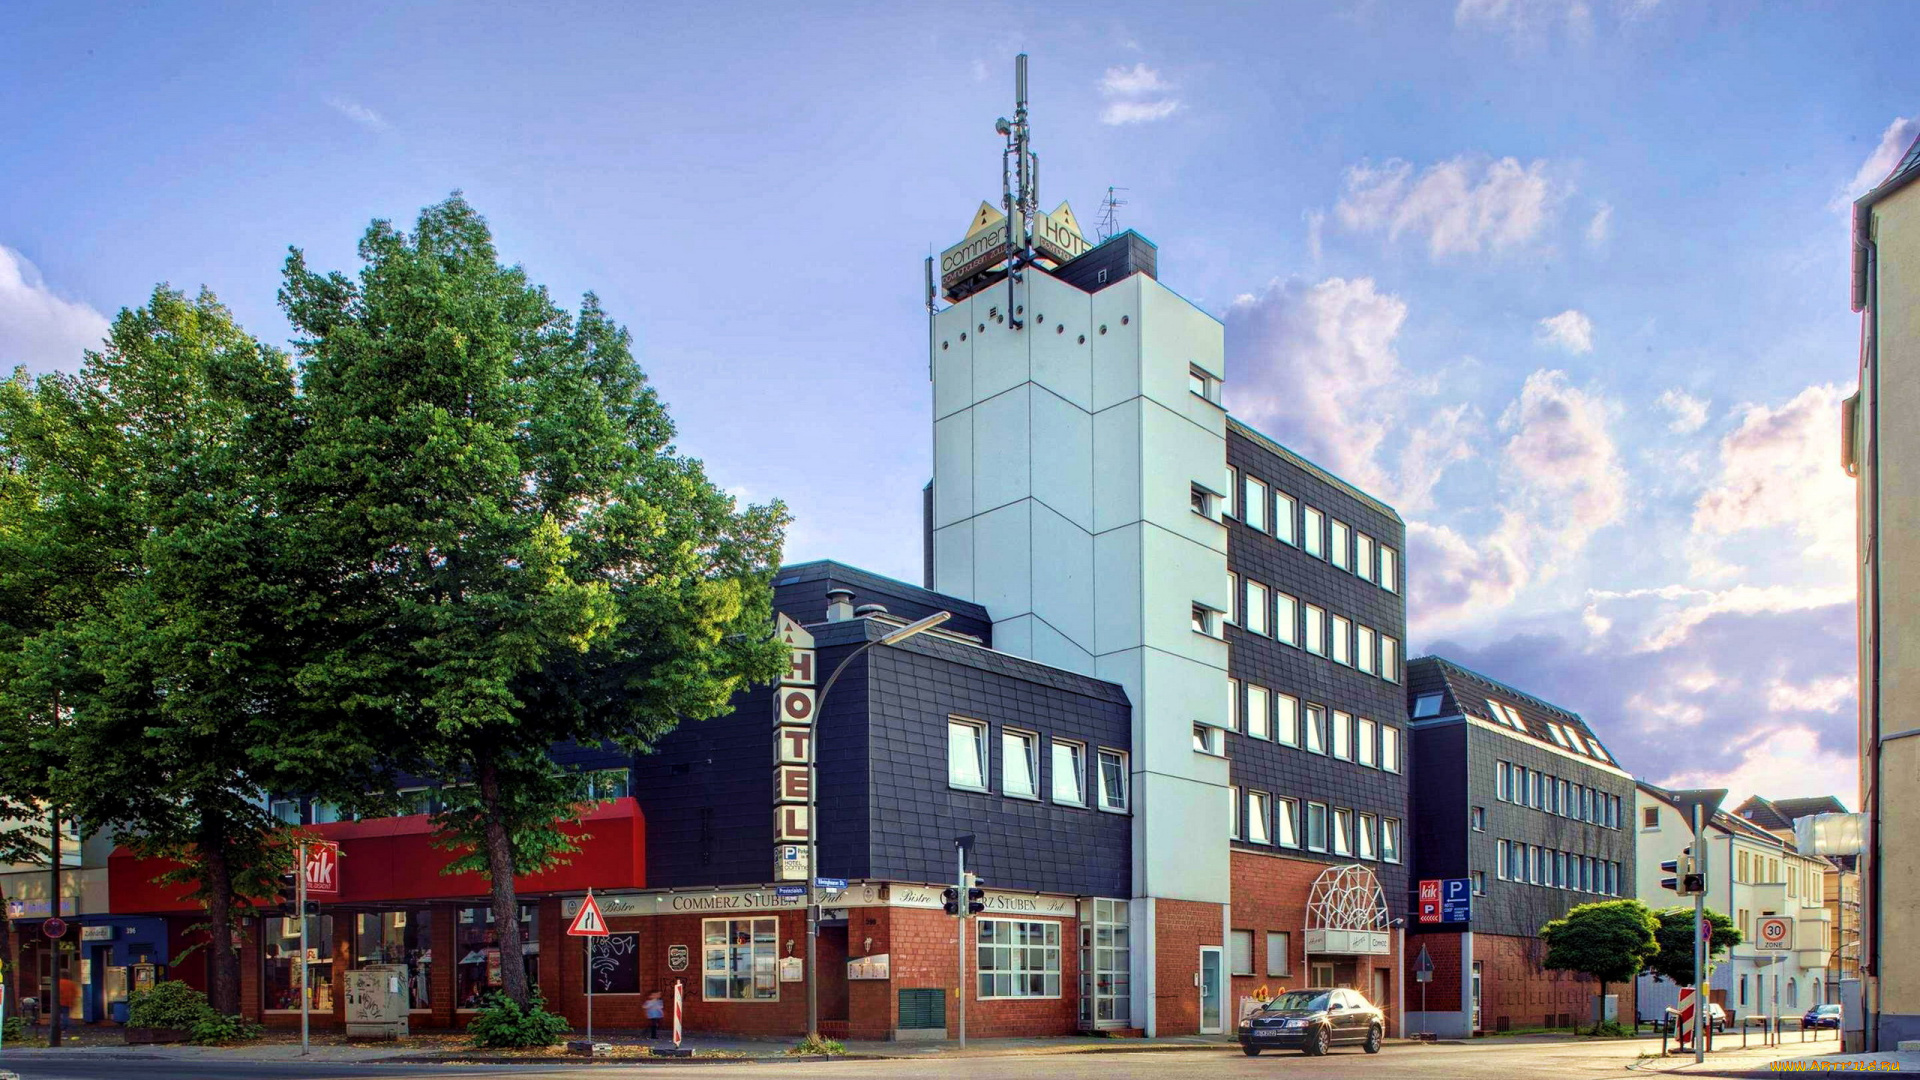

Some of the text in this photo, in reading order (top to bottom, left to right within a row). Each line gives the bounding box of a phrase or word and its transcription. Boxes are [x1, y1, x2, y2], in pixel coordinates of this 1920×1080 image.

[1046, 216, 1093, 255] HOTE
[943, 226, 1008, 272] commer
[785, 654, 812, 837] HOTEL
[816, 891, 845, 903] Pub
[900, 889, 931, 904] Bistro
[1422, 882, 1437, 898] kik
[1450, 881, 1463, 898] P
[601, 901, 635, 912] Bistro
[1047, 900, 1065, 911] Pub
[1424, 904, 1434, 914] P
[1767, 925, 1781, 936] 30
